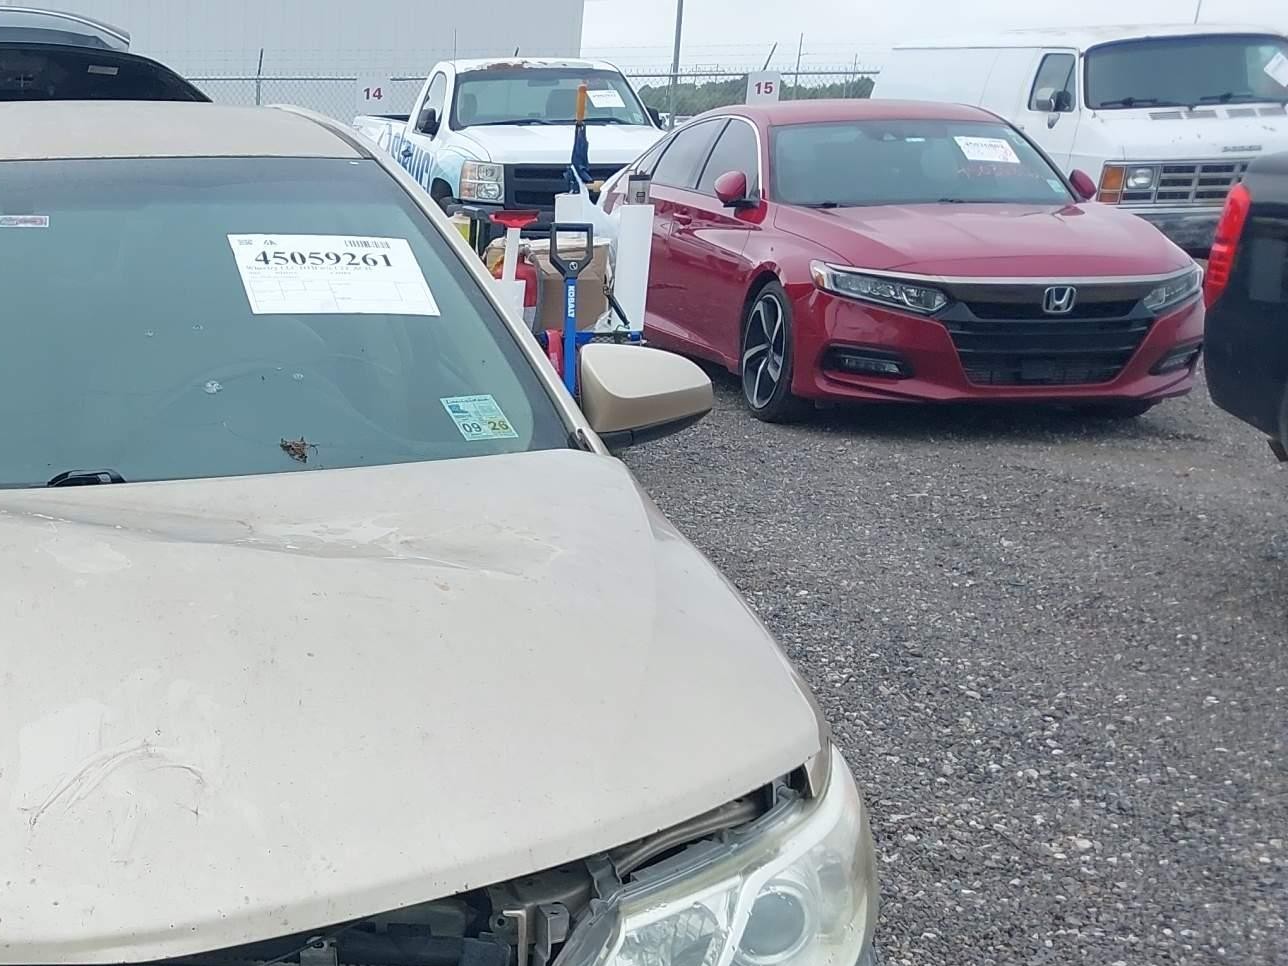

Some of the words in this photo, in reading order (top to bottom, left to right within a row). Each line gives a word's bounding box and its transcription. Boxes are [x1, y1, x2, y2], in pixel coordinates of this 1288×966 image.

[363, 87, 383, 100] 14
[755, 81, 773, 95] 15
[254, 249, 393, 268] 45059261
[567, 285, 576, 318] KOBALT
[462, 422, 482, 433] 09
